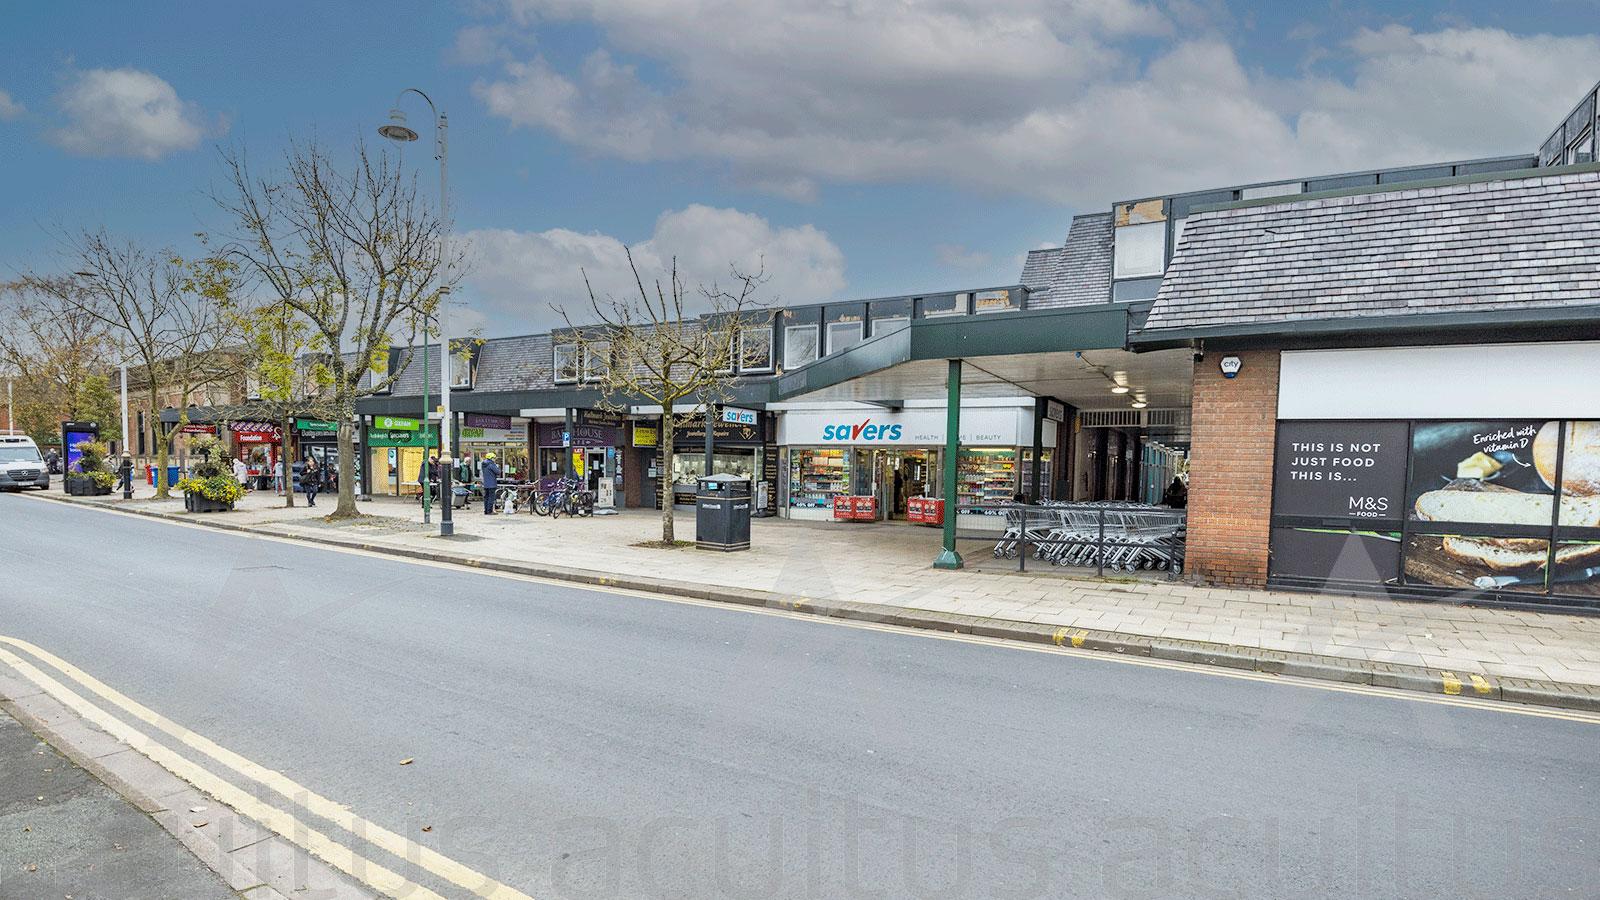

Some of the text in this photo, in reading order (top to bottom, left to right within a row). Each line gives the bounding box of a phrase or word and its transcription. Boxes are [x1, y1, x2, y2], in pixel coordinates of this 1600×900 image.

[1224, 361, 1239, 369] city
[726, 410, 753, 423] savers
[823, 418, 903, 440] savers
[1473, 425, 1536, 444] Enriched with
[1292, 443, 1381, 453] THIS IS NOT
[1483, 437, 1529, 453] vitamin D
[1291, 457, 1375, 467] JUST FOOD
[1290, 471, 1357, 481] THIS IS...
[1349, 496, 1388, 511] M&S
